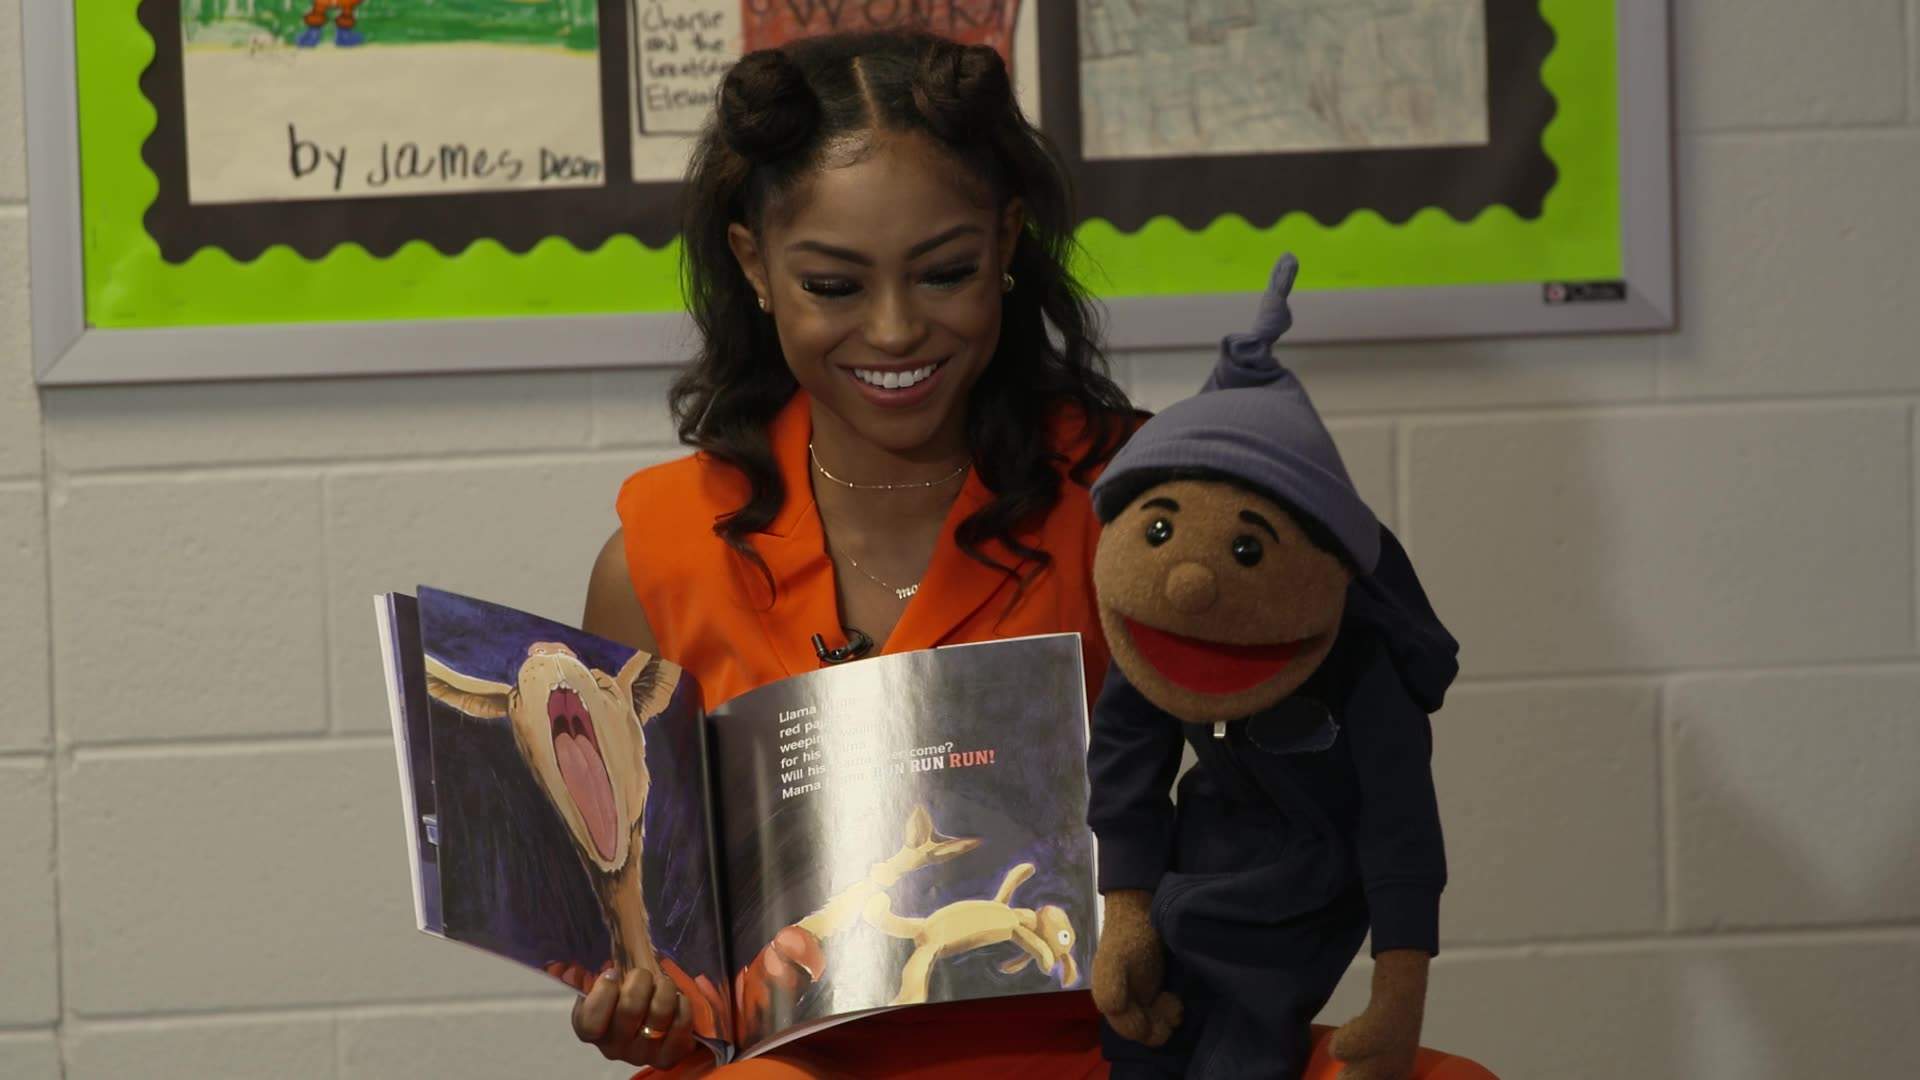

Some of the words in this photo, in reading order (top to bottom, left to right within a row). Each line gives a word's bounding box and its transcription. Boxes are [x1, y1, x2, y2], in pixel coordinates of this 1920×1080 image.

[288, 123, 346, 191] by
[779, 706, 817, 723] Llama
[780, 723, 801, 738] red
[781, 756, 799, 769] for
[803, 750, 822, 763] his
[781, 768, 803, 784] Will
[807, 764, 826, 777] his
[909, 741, 954, 757] come?
[782, 781, 822, 800] Mama
[911, 755, 945, 774] RUN
[948, 749, 996, 769] RUN!
